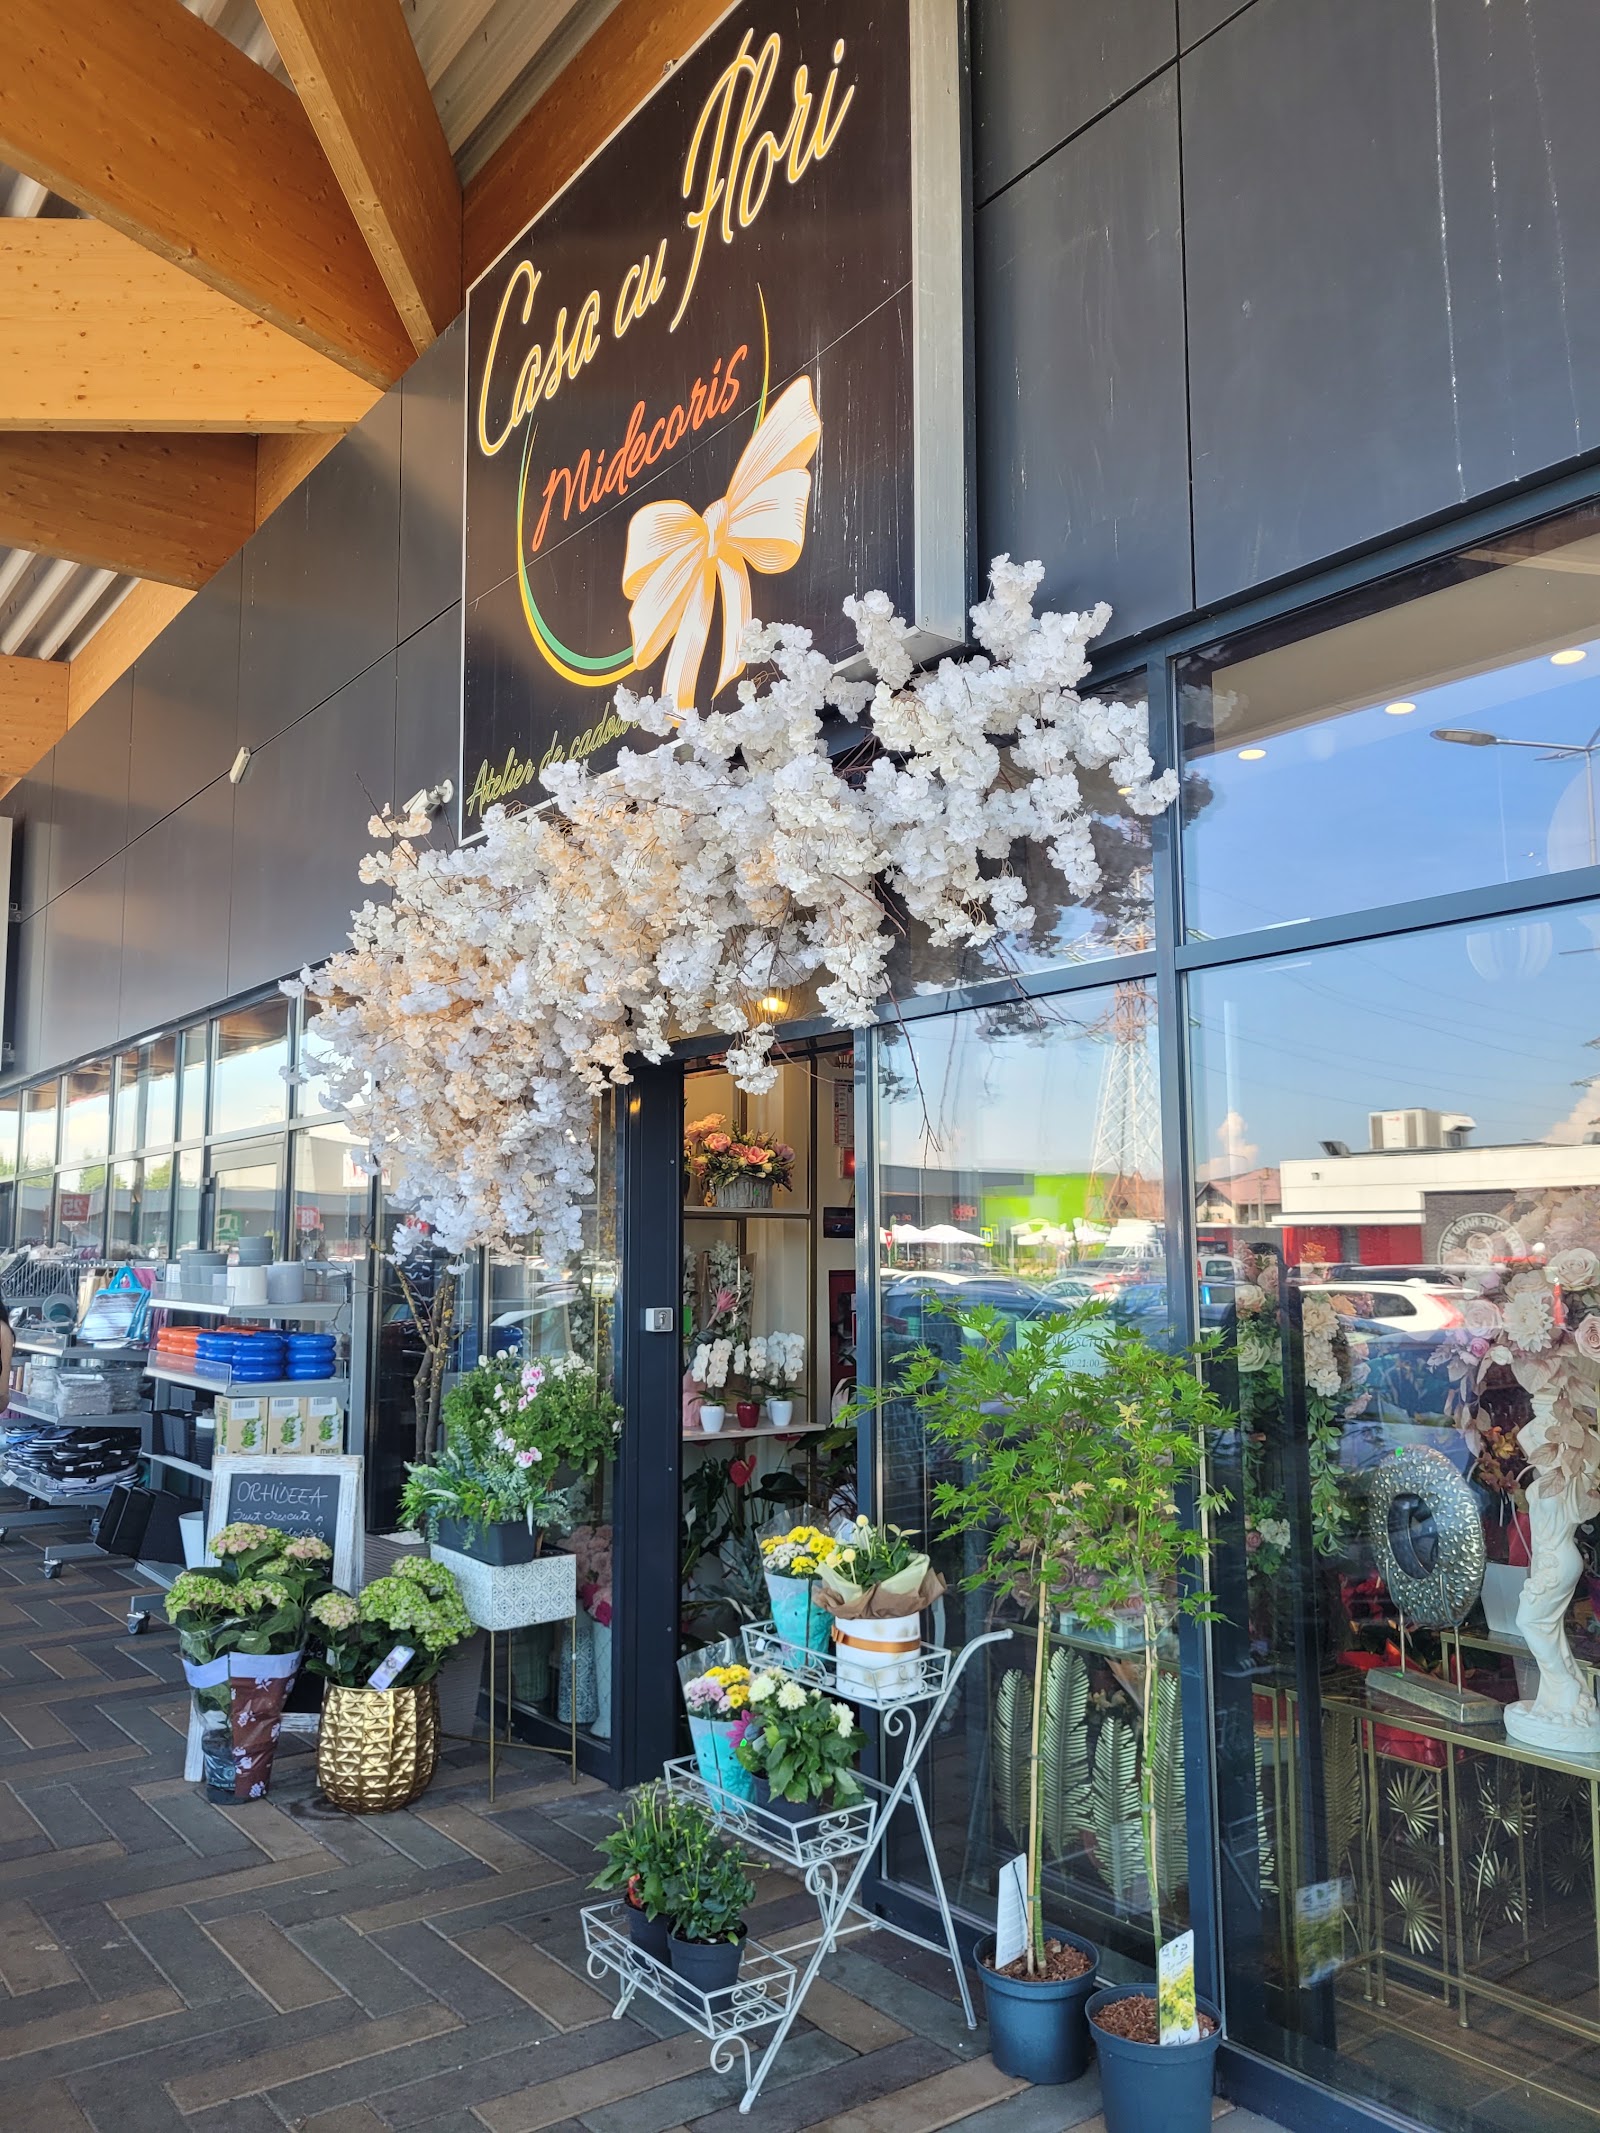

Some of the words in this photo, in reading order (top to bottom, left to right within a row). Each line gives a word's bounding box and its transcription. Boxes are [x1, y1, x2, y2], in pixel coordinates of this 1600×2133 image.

[479, 260, 601, 456] Casa
[614, 238, 667, 338] cu
[670, 27, 855, 333] Flori
[532, 344, 748, 552] Midecoris
[466, 747, 536, 818] Atelier
[538, 730, 566, 775] de
[237, 1481, 329, 1509] ORHIDEEA
